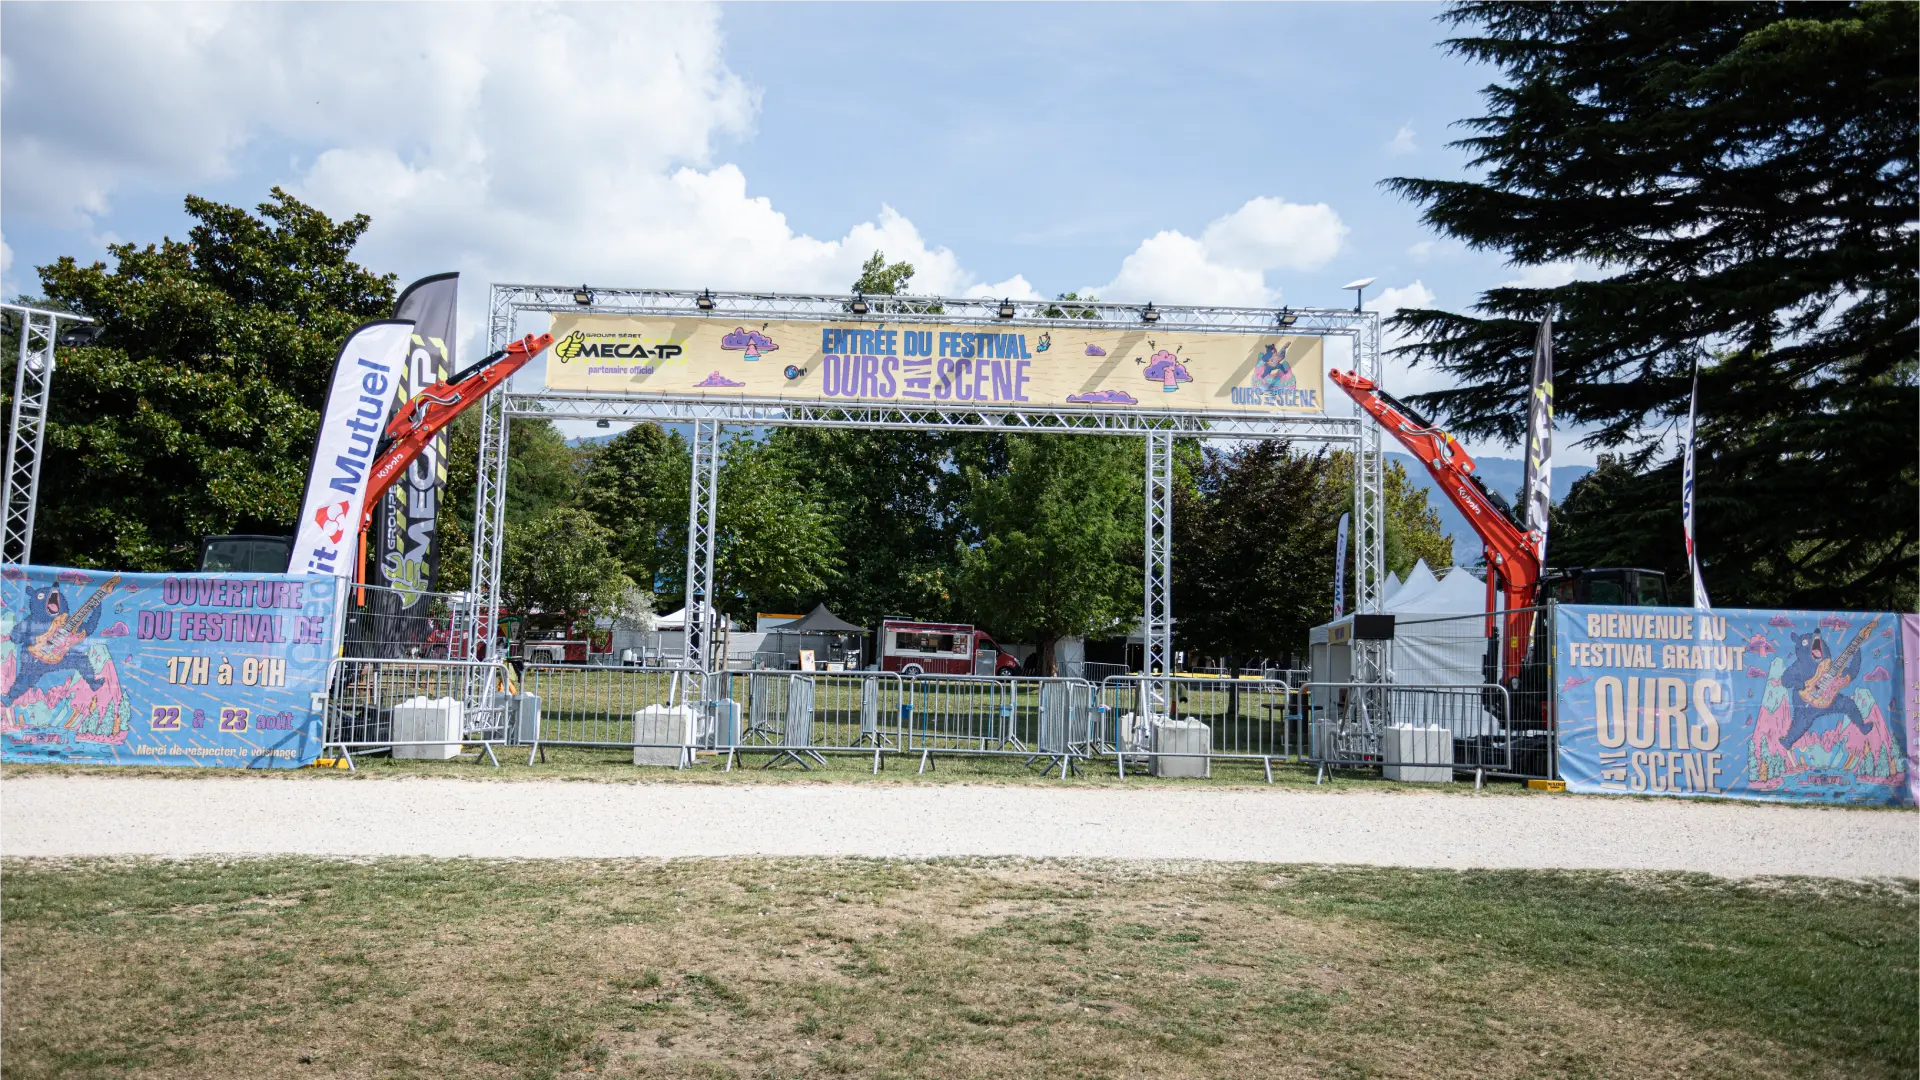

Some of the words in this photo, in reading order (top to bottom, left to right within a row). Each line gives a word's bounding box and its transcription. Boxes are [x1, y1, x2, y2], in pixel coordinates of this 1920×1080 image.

[575, 343, 683, 359] MECA-TP
[822, 324, 898, 355] ENTRÉE
[904, 331, 932, 357] DU
[939, 332, 1032, 359] FESTIVAL
[588, 366, 628, 375] partenaire
[629, 367, 654, 375] officiel
[823, 354, 899, 398] OURS
[934, 357, 1031, 402] SCENE
[1231, 386, 1263, 405] OURS
[1276, 388, 1316, 407] SCENE
[329, 358, 390, 496] Mutuel
[377, 453, 403, 479] Kubota
[1458, 486, 1481, 515] Kubota
[387, 485, 397, 549] GROUPE
[163, 577, 304, 609] OUVERTURE
[137, 611, 172, 640] DU
[179, 611, 286, 643] FESTIVAL
[293, 616, 325, 644] DE
[1587, 613, 1694, 640] BIENVENUE
[1700, 616, 1727, 641] AU
[167, 656, 209, 685] 17H
[217, 657, 233, 685] à
[242, 658, 286, 687] 01H
[1570, 643, 1657, 668] FESTIVAL
[1662, 645, 1746, 671] GRATUIT
[152, 707, 180, 729] 22
[192, 709, 205, 729] &
[221, 708, 248, 730] 23
[256, 711, 293, 730] août
[1594, 675, 1723, 751] OURS
[137, 744, 165, 756] Merci
[169, 745, 182, 756] de
[184, 746, 235, 759] respecter
[239, 747, 248, 757] le
[251, 748, 296, 759] voisinage
[1631, 751, 1723, 794] SCENE
